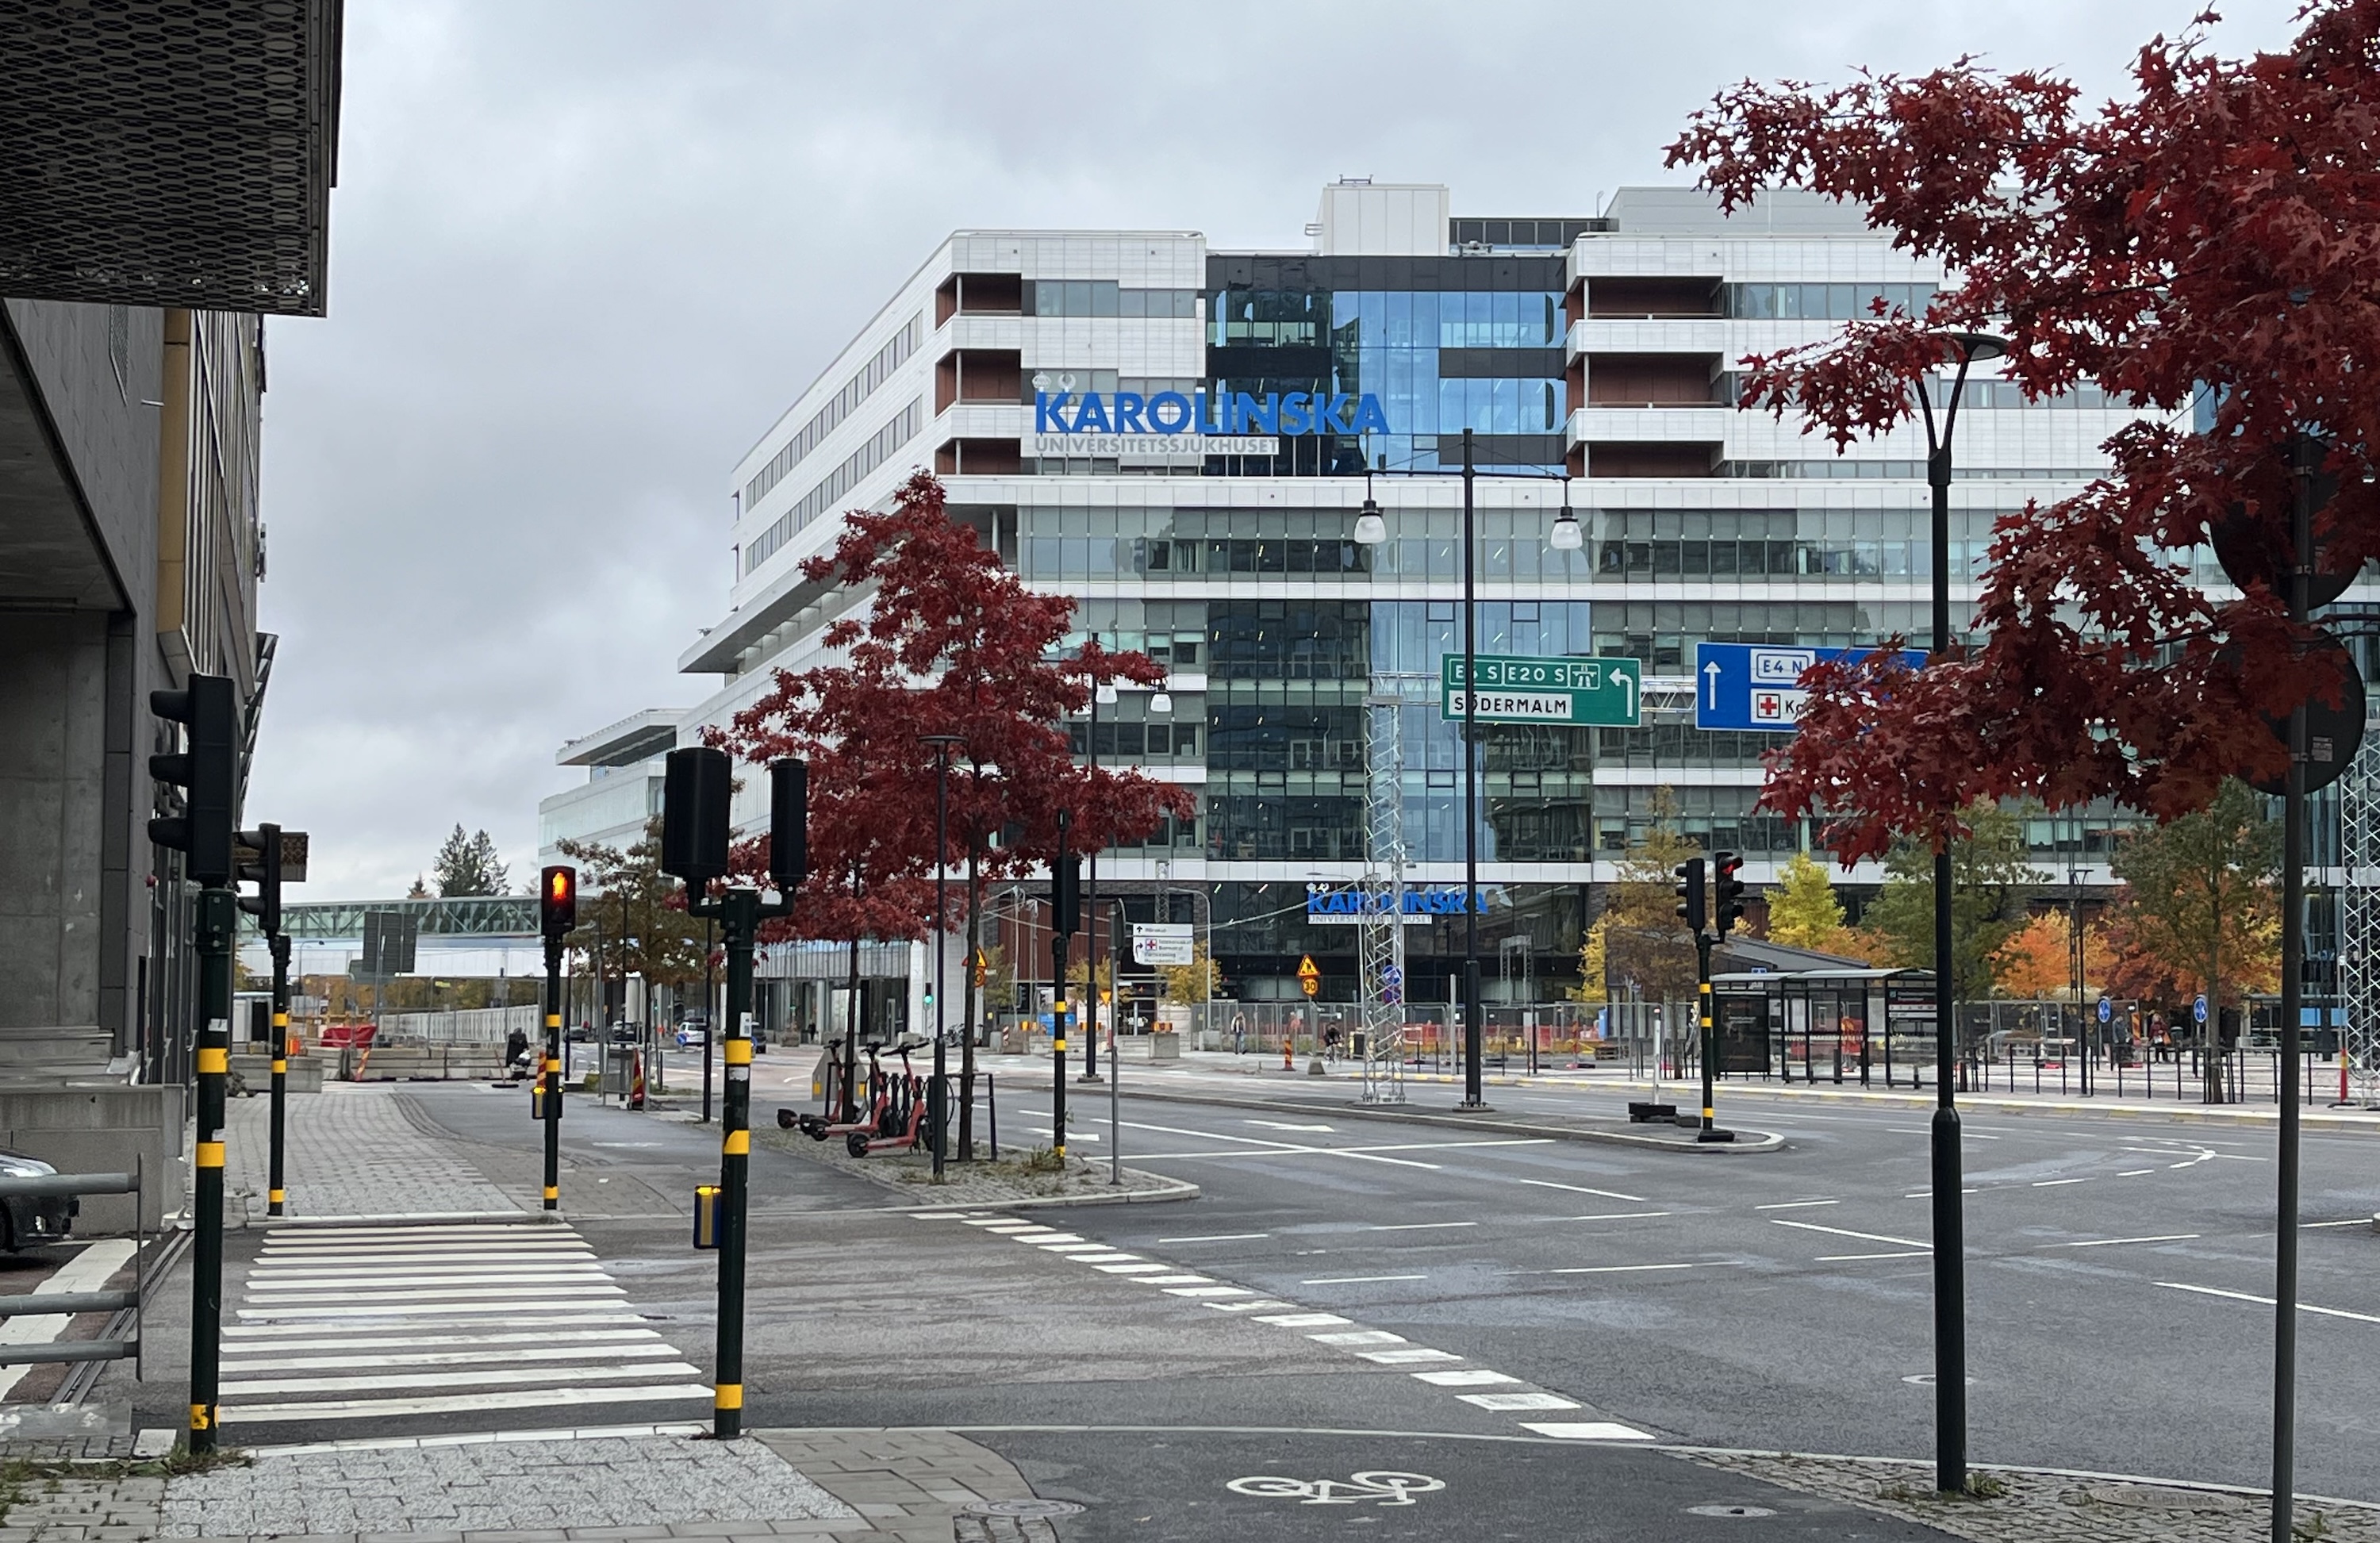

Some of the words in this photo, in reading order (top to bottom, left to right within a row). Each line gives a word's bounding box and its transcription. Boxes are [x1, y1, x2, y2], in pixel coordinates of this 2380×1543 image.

[1035, 391, 1390, 436] KAROLINSKA
[1035, 437, 1279, 453] UNIVERSITETSSJUKHUSET
[1487, 666, 1498, 680] S
[1507, 666, 1546, 682] E20
[1554, 668, 1565, 682] S
[1763, 659, 1783, 673] E4
[1792, 660, 1802, 674] N
[1304, 981, 1316, 991] 30
